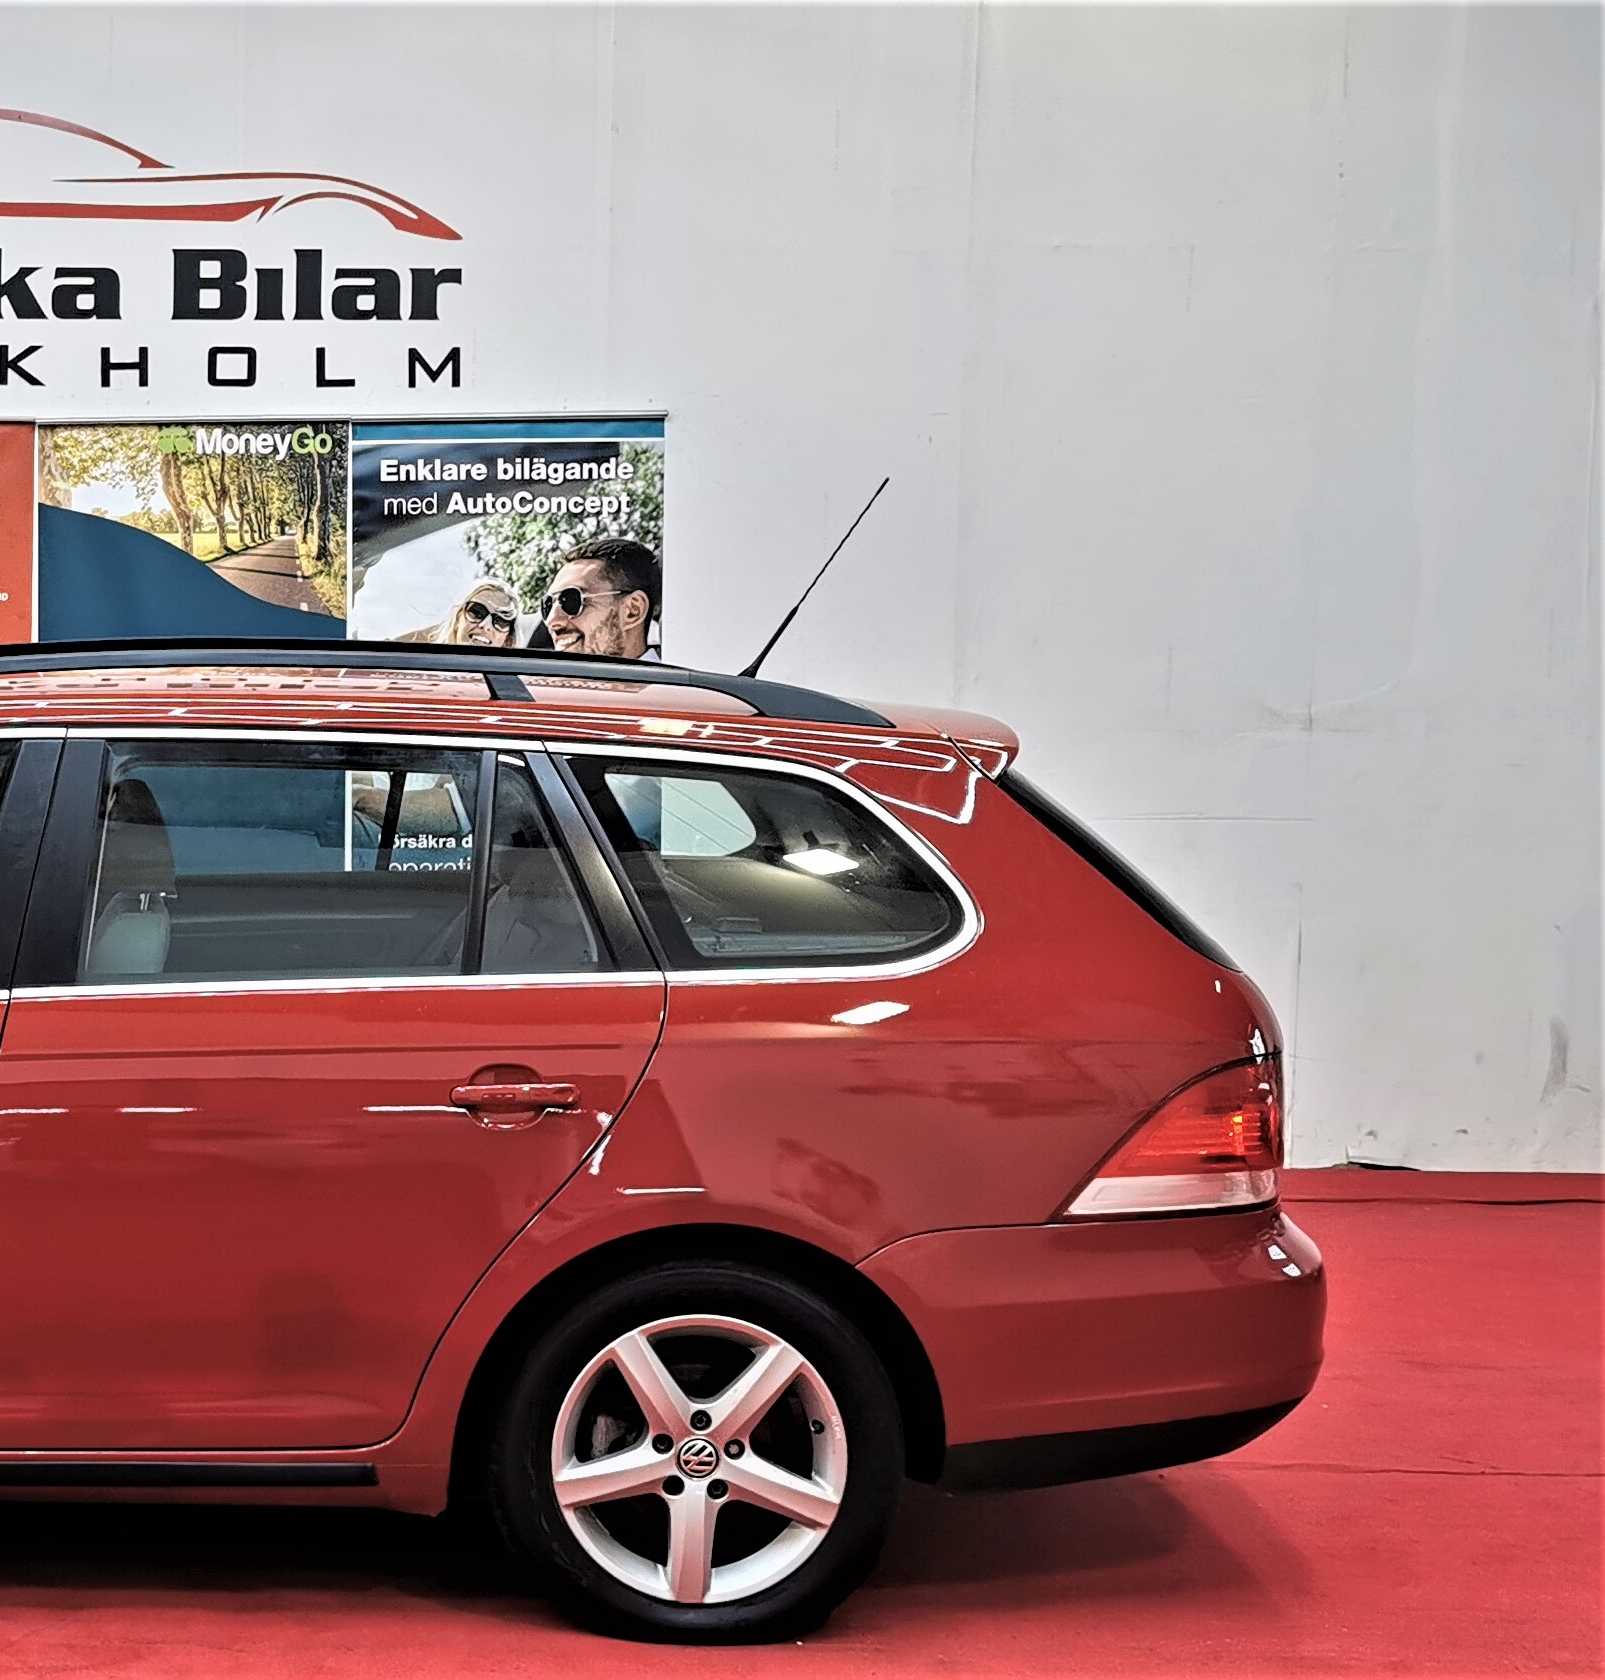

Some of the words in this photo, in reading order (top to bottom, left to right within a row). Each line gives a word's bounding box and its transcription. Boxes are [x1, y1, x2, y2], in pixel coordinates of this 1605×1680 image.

[196, 426, 333, 461] MoneyGo
[380, 459, 488, 482] Enklare
[497, 457, 634, 484] bilägande
[384, 492, 438, 515] med
[446, 491, 631, 518] AutoConcept
